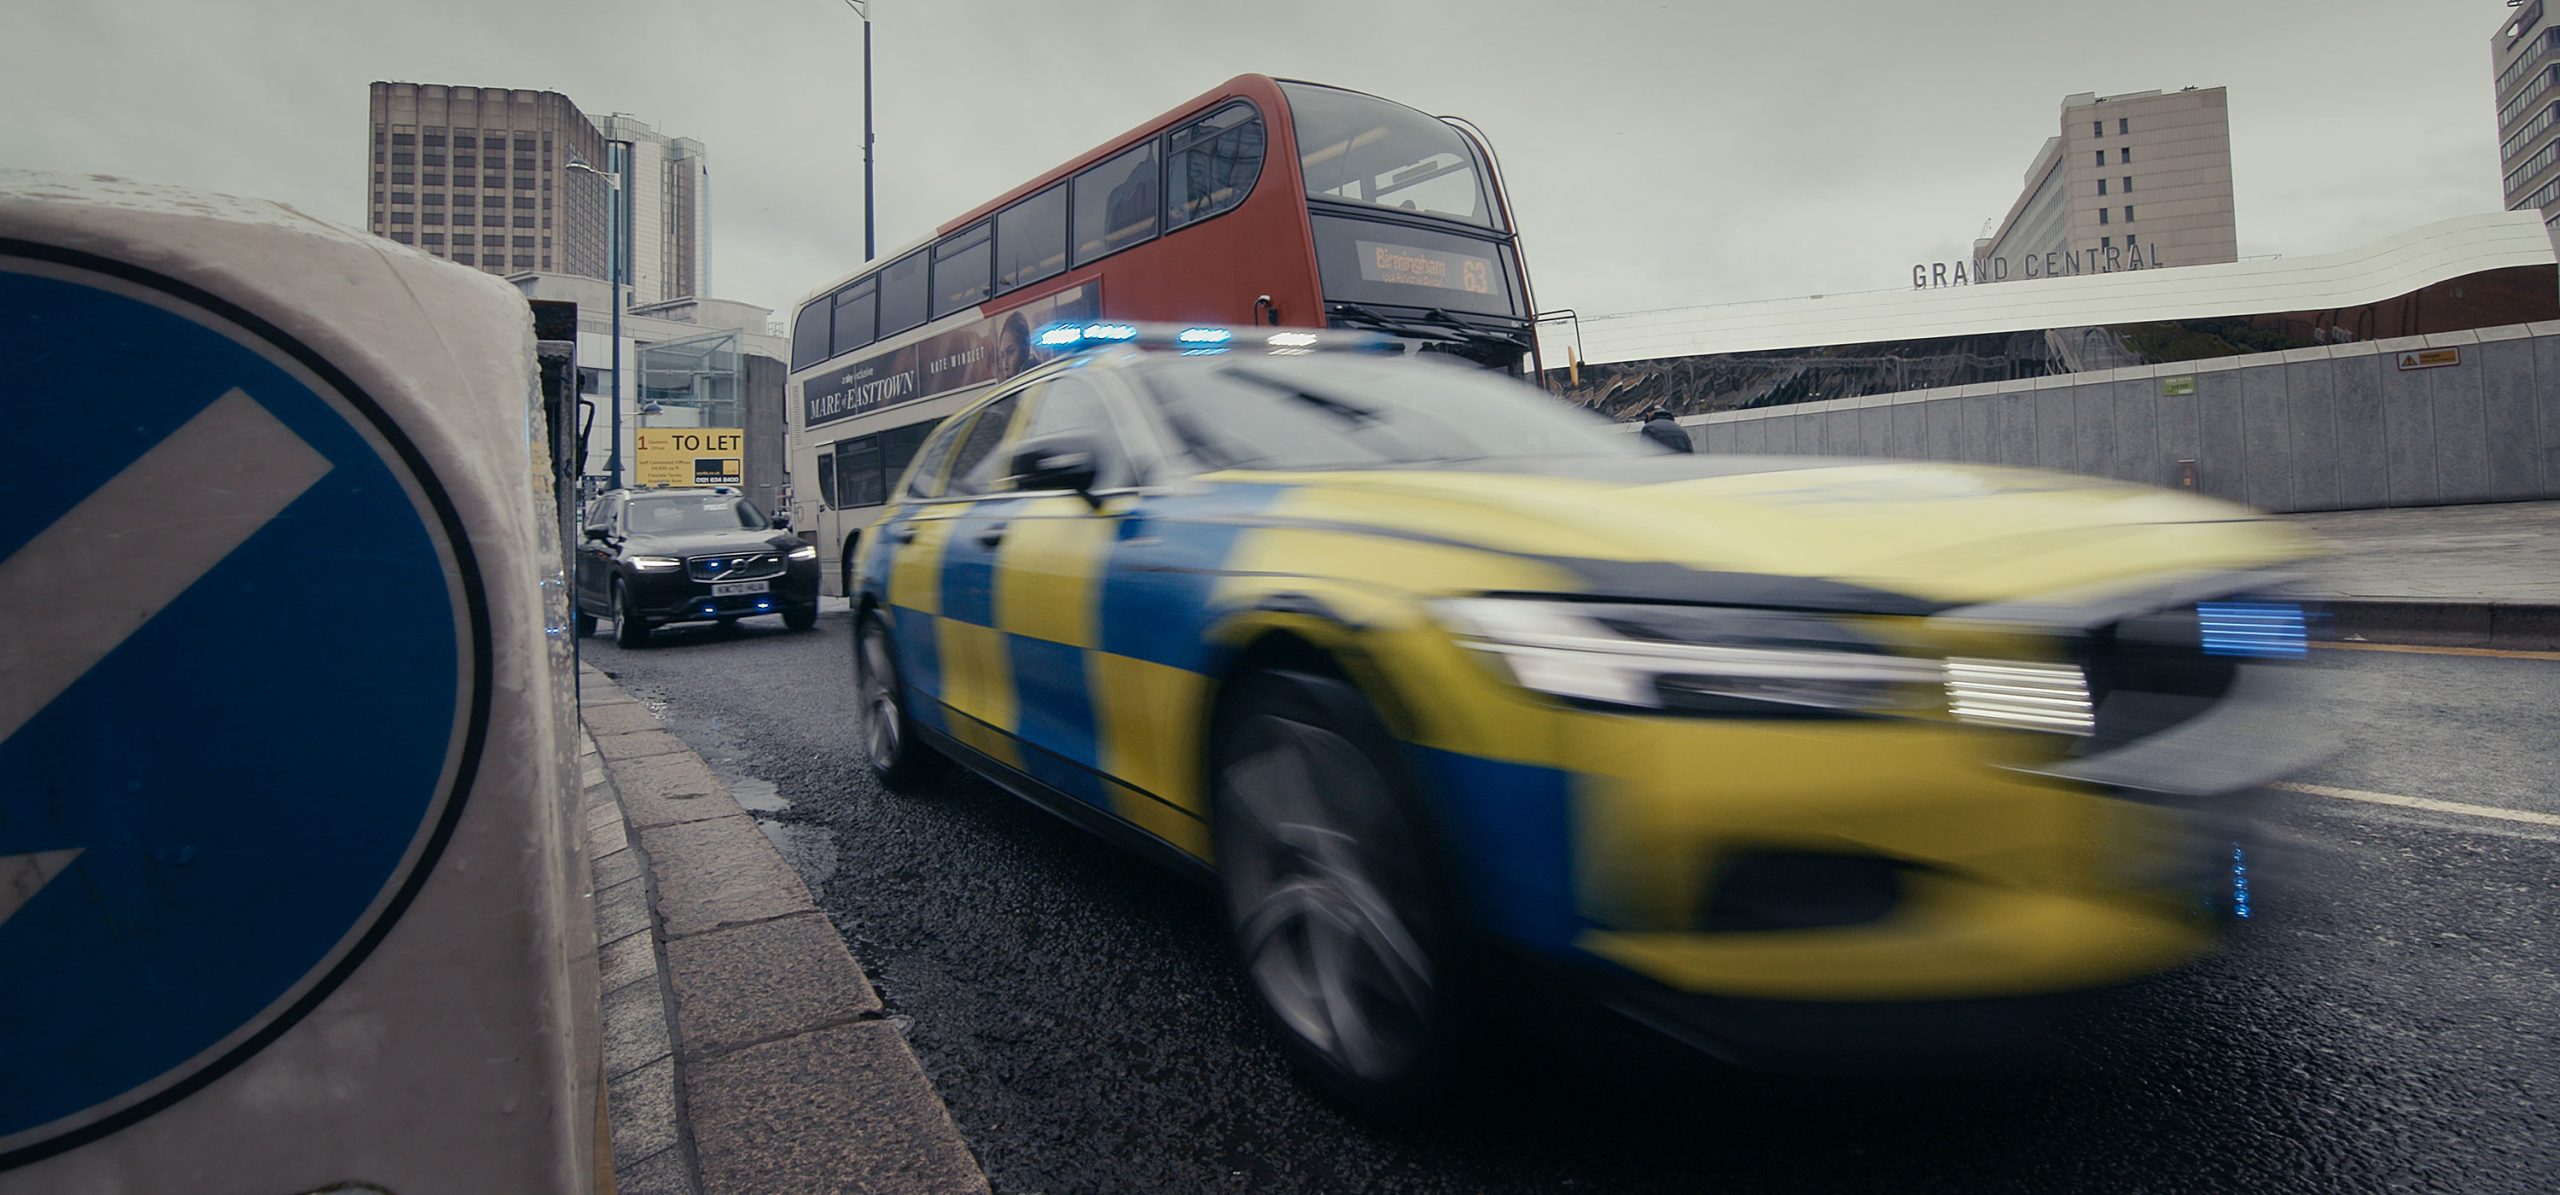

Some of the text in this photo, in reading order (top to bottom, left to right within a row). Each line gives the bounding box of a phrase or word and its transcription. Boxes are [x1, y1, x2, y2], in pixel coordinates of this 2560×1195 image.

[1376, 247, 1446, 277] Birmingham
[1463, 260, 1489, 293] 63
[1913, 243, 2164, 289] GRAND CENTRAL
[930, 346, 985, 374] KATE WINSLET
[810, 392, 841, 420] MARE
[847, 370, 915, 410] EASTTOWN
[638, 435, 648, 451] 1
[672, 435, 741, 451] TO LET
